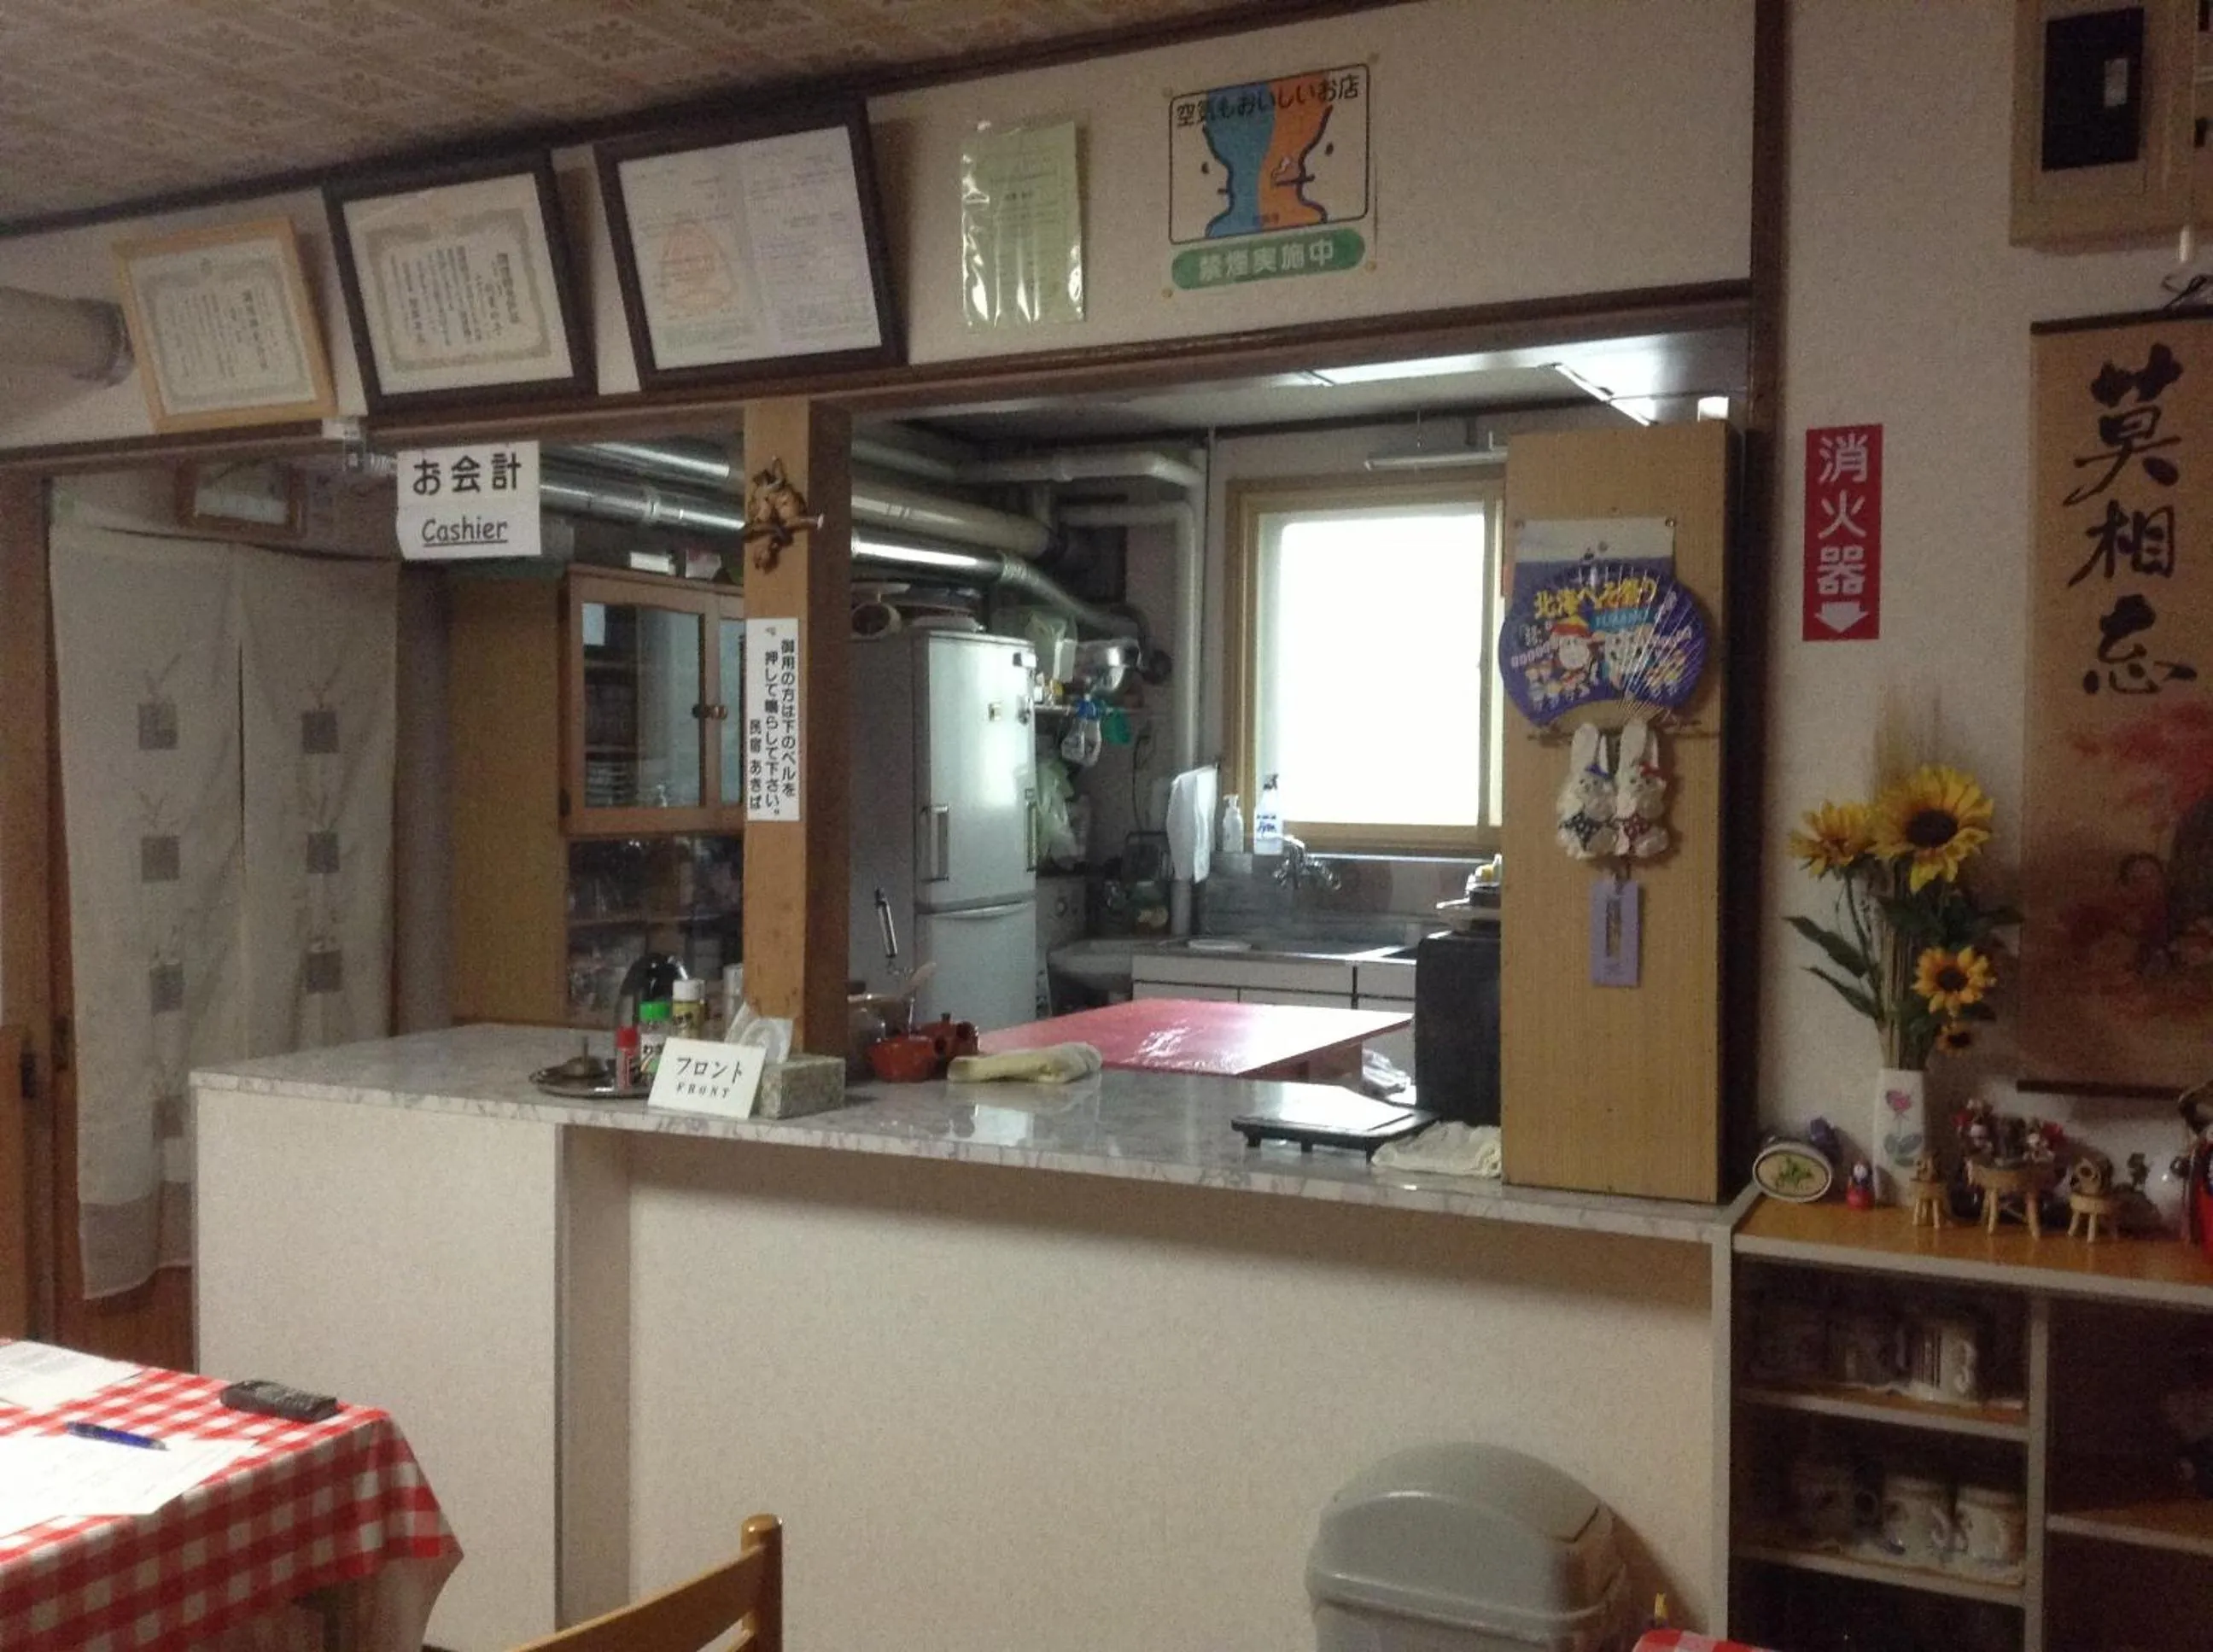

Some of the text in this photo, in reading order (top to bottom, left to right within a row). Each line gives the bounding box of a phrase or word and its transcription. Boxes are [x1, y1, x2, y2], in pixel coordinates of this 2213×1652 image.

[1177, 73, 1360, 127] 空気もおいしいお店
[1199, 238, 1334, 283] 禁煙実施中
[412, 452, 522, 496] お会計
[422, 515, 508, 543] Cashier
[1818, 432, 1869, 595] 消火器
[676, 1056, 742, 1084] フロント
[677, 1082, 731, 1099] FRONT
